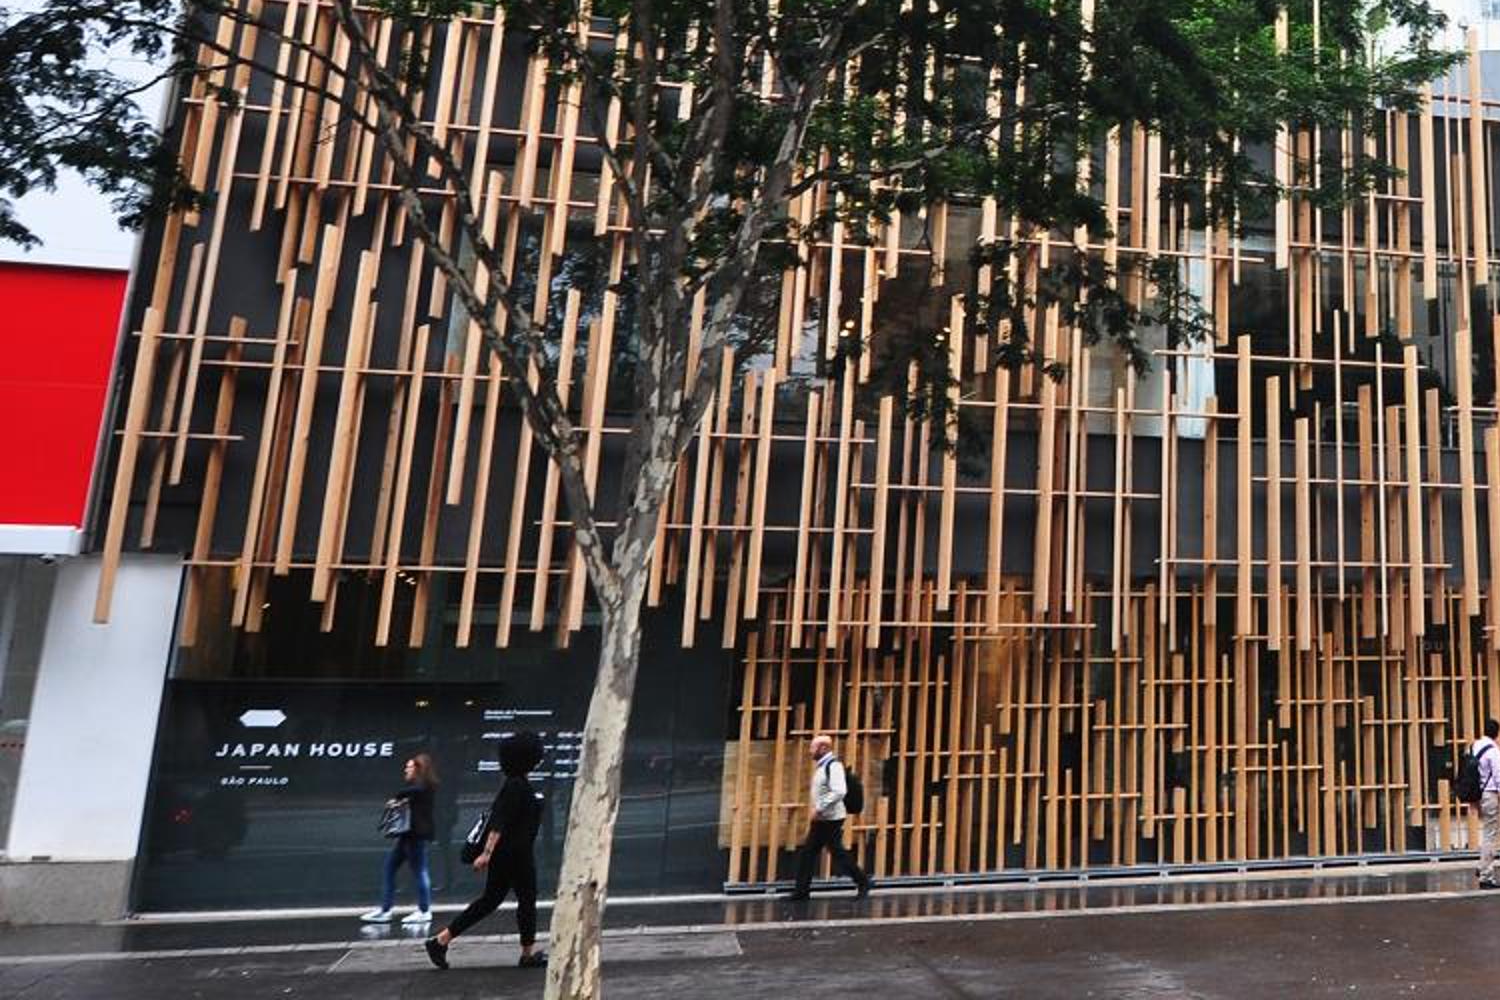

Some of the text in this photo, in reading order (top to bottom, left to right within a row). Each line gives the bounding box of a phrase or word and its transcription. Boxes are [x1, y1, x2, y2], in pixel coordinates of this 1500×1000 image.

[215, 742, 395, 757] JAPAN HOUSE
[220, 775, 289, 785] SÃO PAULO
